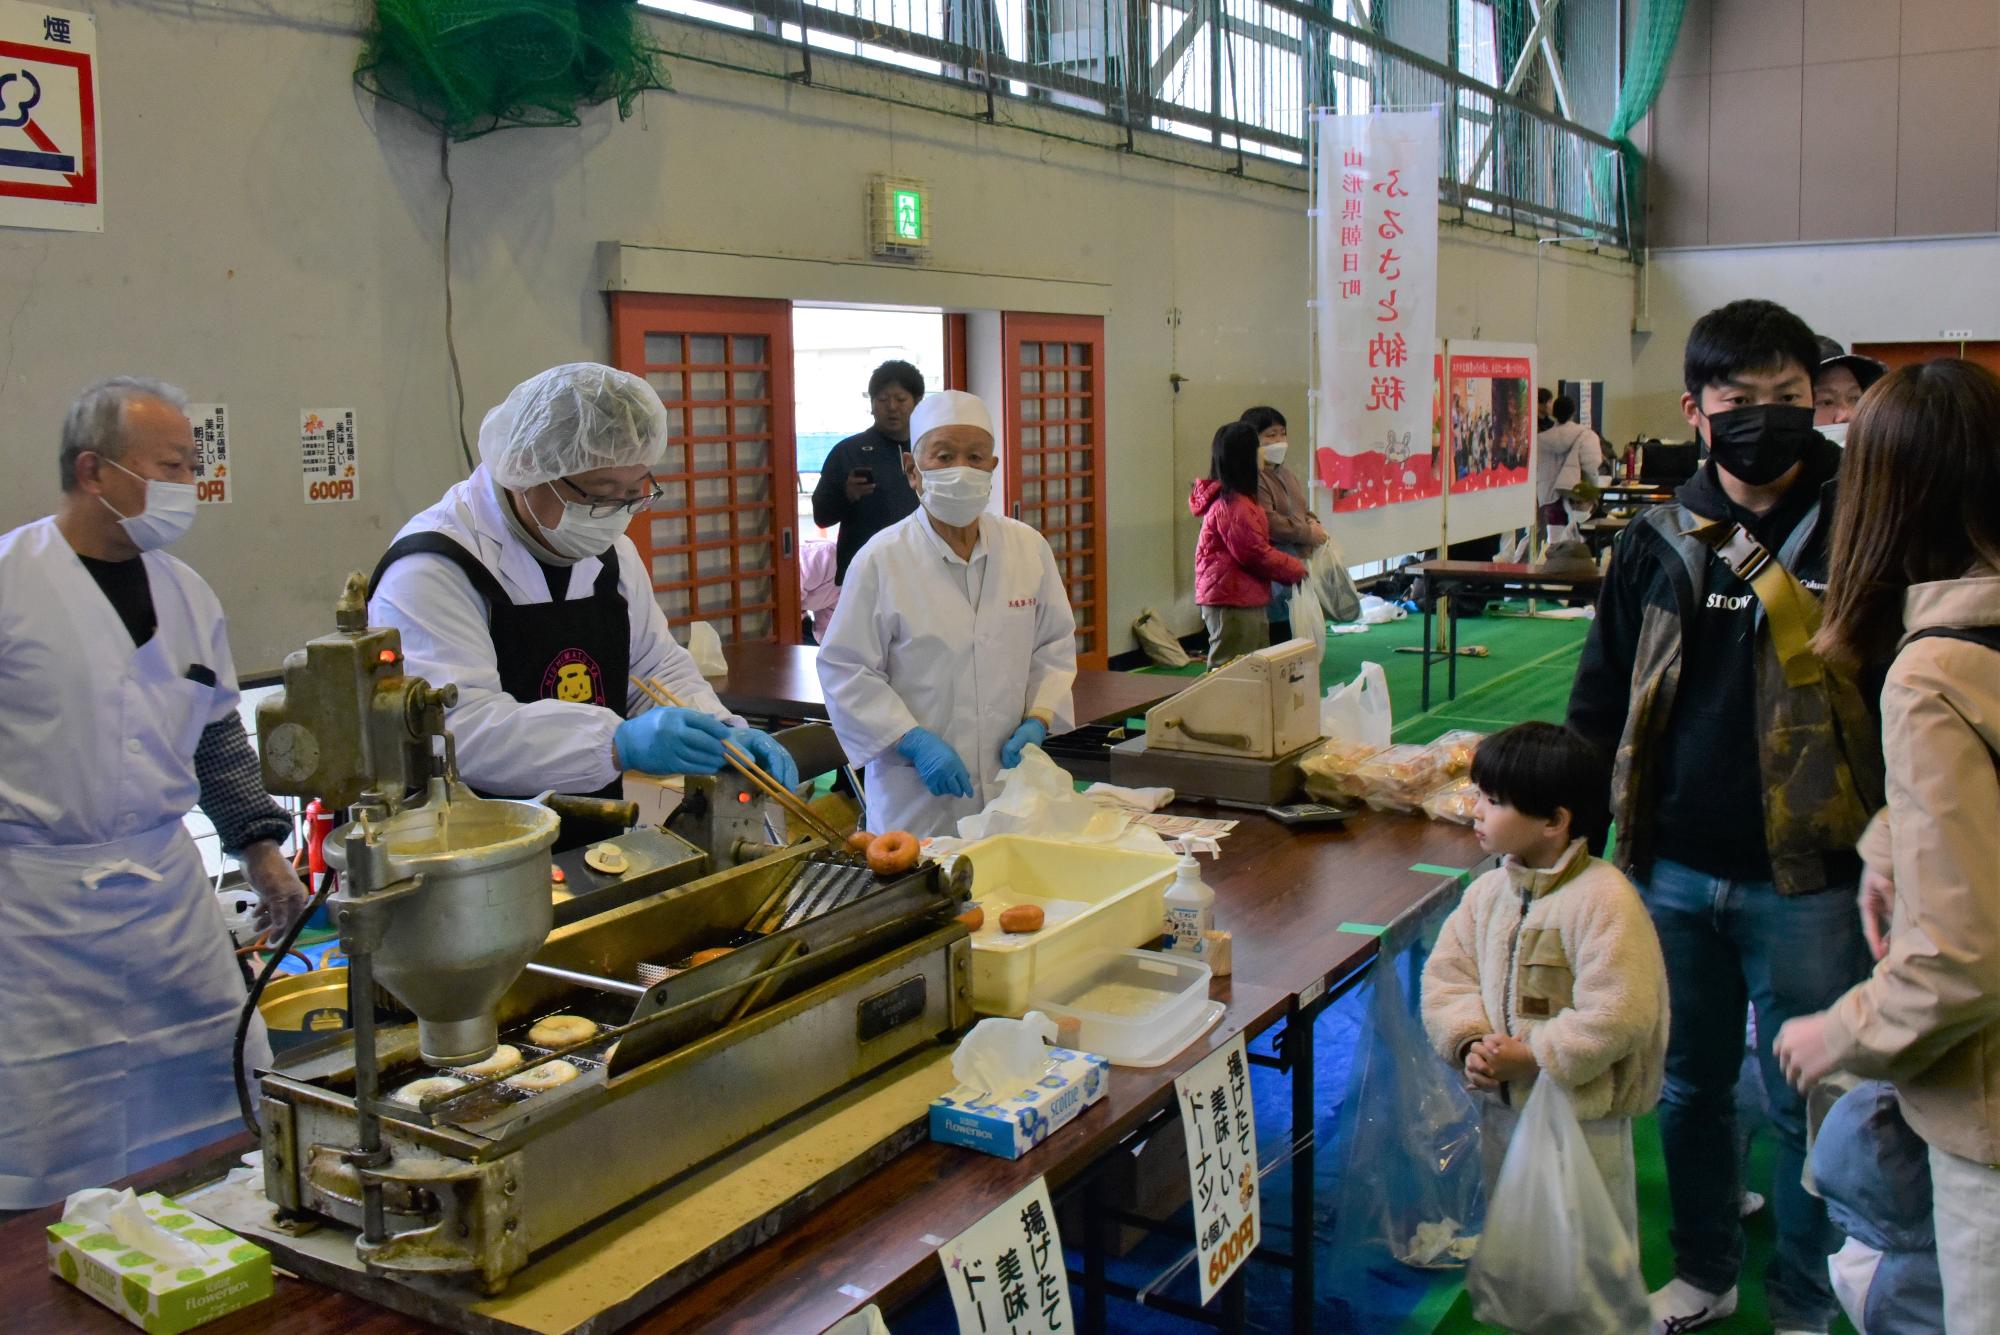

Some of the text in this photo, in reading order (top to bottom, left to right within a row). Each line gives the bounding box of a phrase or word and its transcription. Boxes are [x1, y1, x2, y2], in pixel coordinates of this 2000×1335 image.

[43, 14, 72, 44] 煙
[204, 418, 216, 465] 美味しい
[336, 422, 346, 466] 美味しい
[309, 479, 354, 500] 600円
[1706, 593, 1753, 610] snow
[1227, 1050, 1250, 1156] 揚げたて
[1190, 1091, 1214, 1213] ドーナツ
[1210, 1085, 1235, 1197] 美味しい
[1201, 1212, 1231, 1252] 6個入
[1208, 1213, 1254, 1288] 600円
[996, 1247, 1032, 1335] 美味
[1020, 1199, 1062, 1332] 揚げたて
